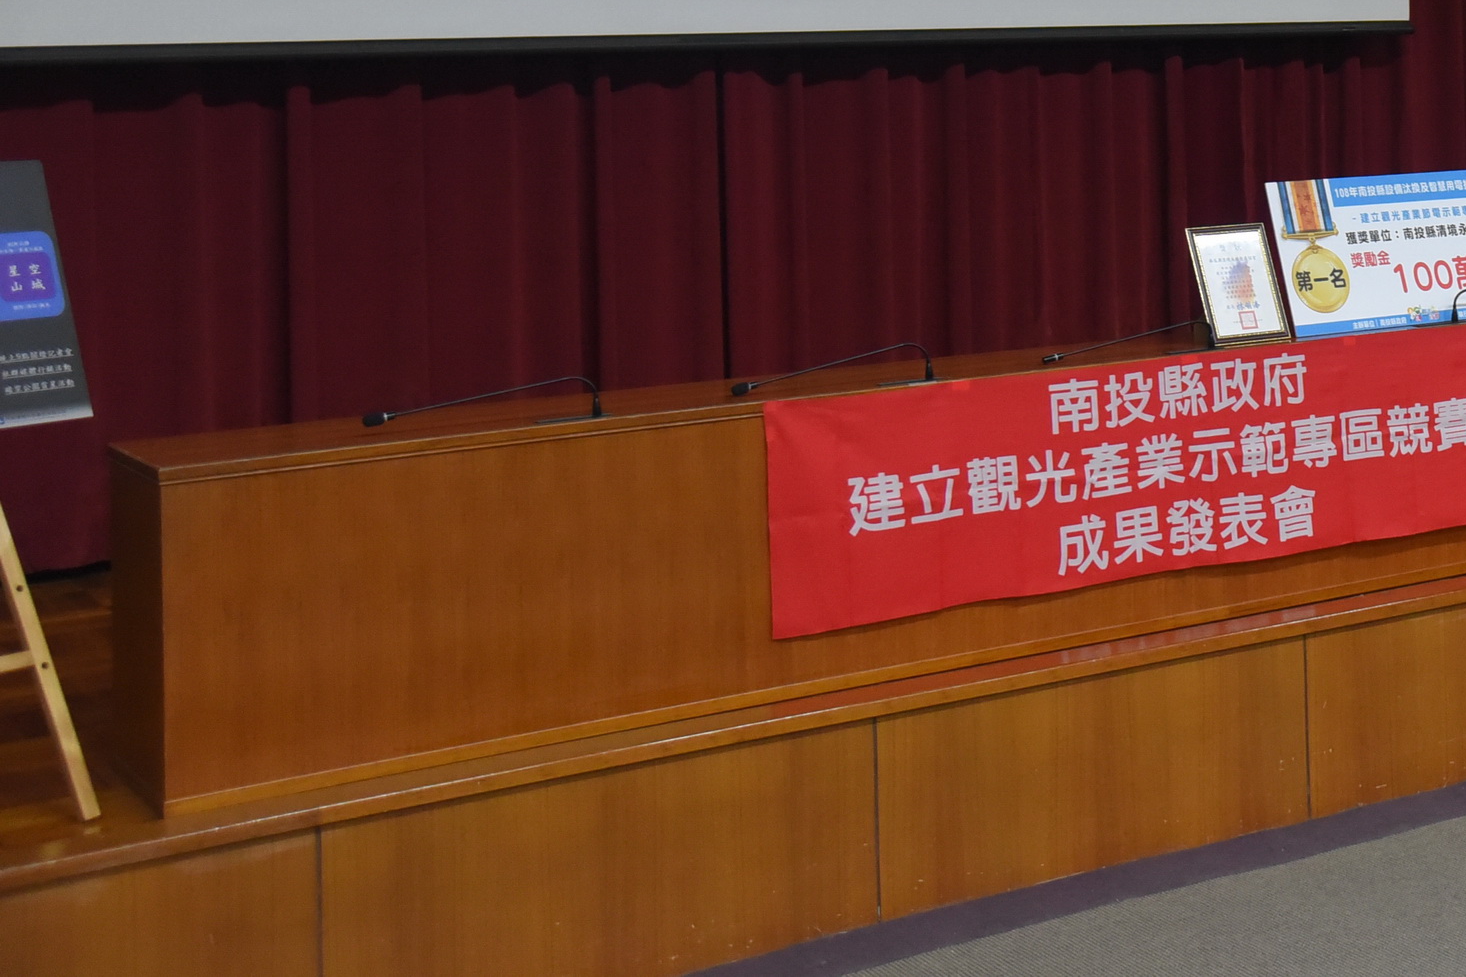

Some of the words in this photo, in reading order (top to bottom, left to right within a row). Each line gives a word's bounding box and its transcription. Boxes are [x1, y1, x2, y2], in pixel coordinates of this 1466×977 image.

[1295, 267, 1348, 292] 第一名
[1350, 250, 1391, 268] 獎勵金
[1048, 352, 1308, 435] 南投縣政府
[1057, 485, 1316, 577] 成果發表會
